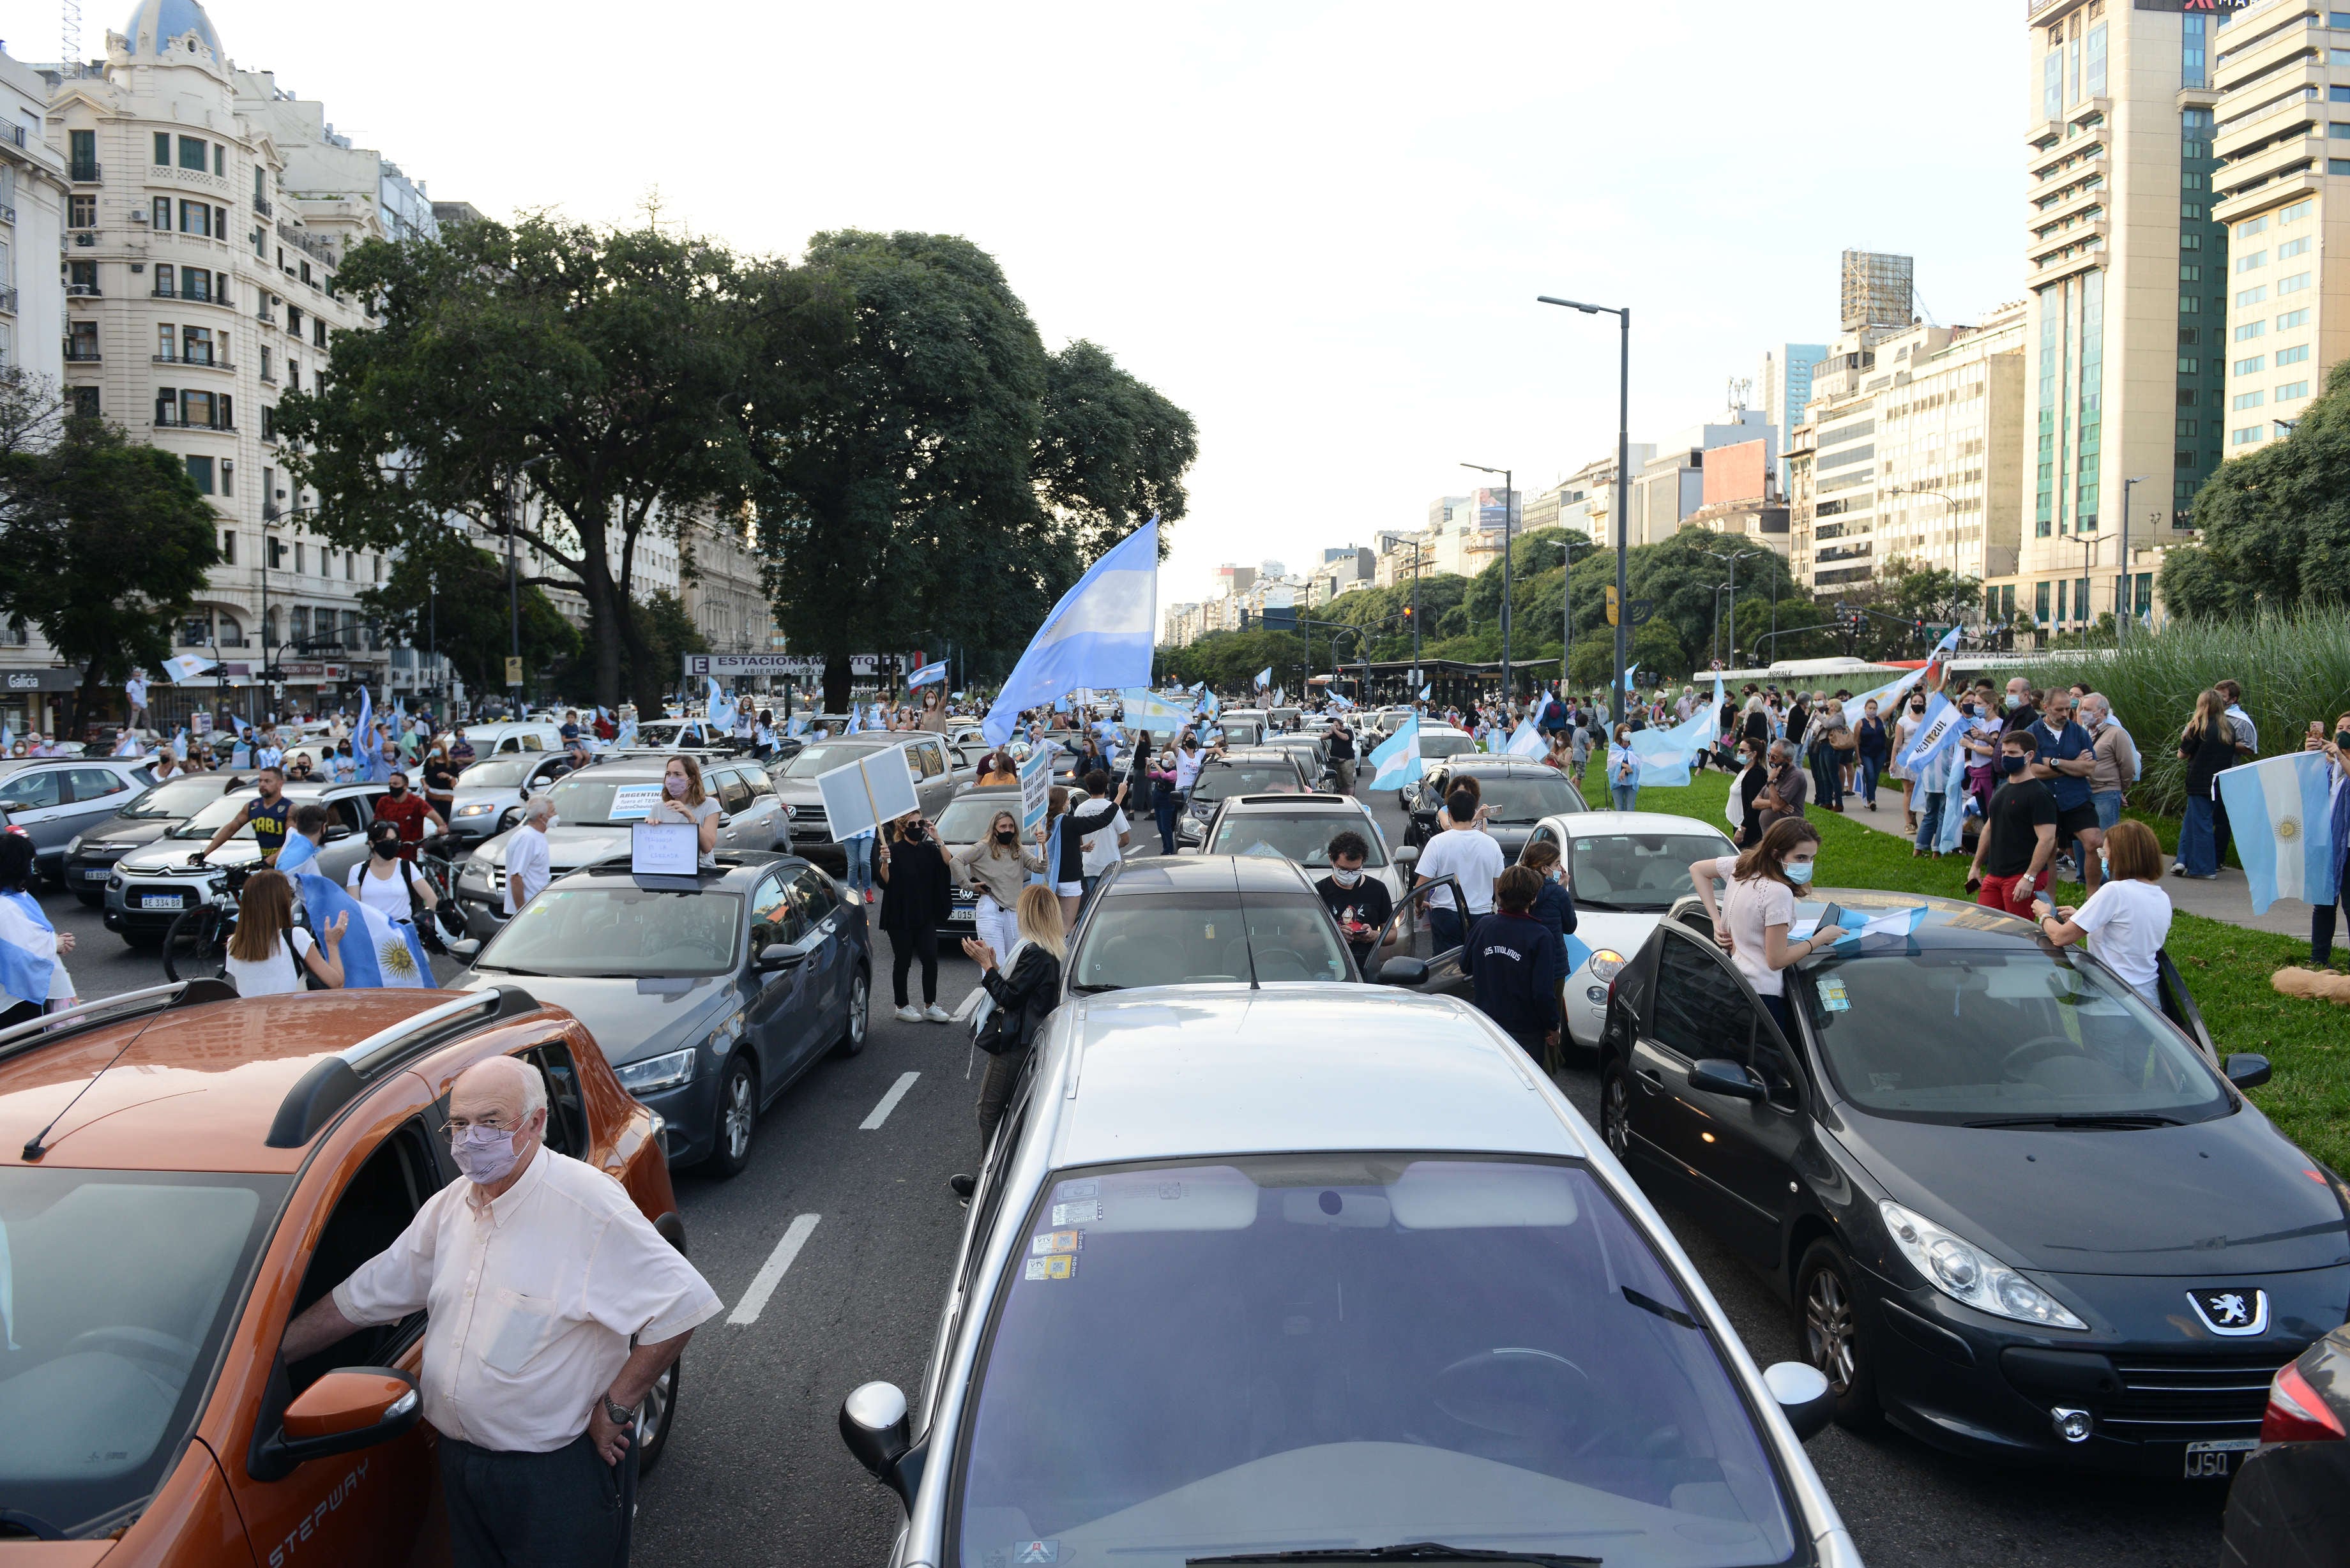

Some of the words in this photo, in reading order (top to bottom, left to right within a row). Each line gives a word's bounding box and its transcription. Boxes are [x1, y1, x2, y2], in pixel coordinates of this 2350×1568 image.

[8, 674, 38, 688] Galicia
[144, 897, 153, 907] AE
[155, 897, 169, 907] 334
[171, 897, 180, 907] BR
[958, 911, 971, 919] 015
[1494, 946, 1522, 961] MOLINOS
[269, 1457, 368, 1568] STEPWAY
